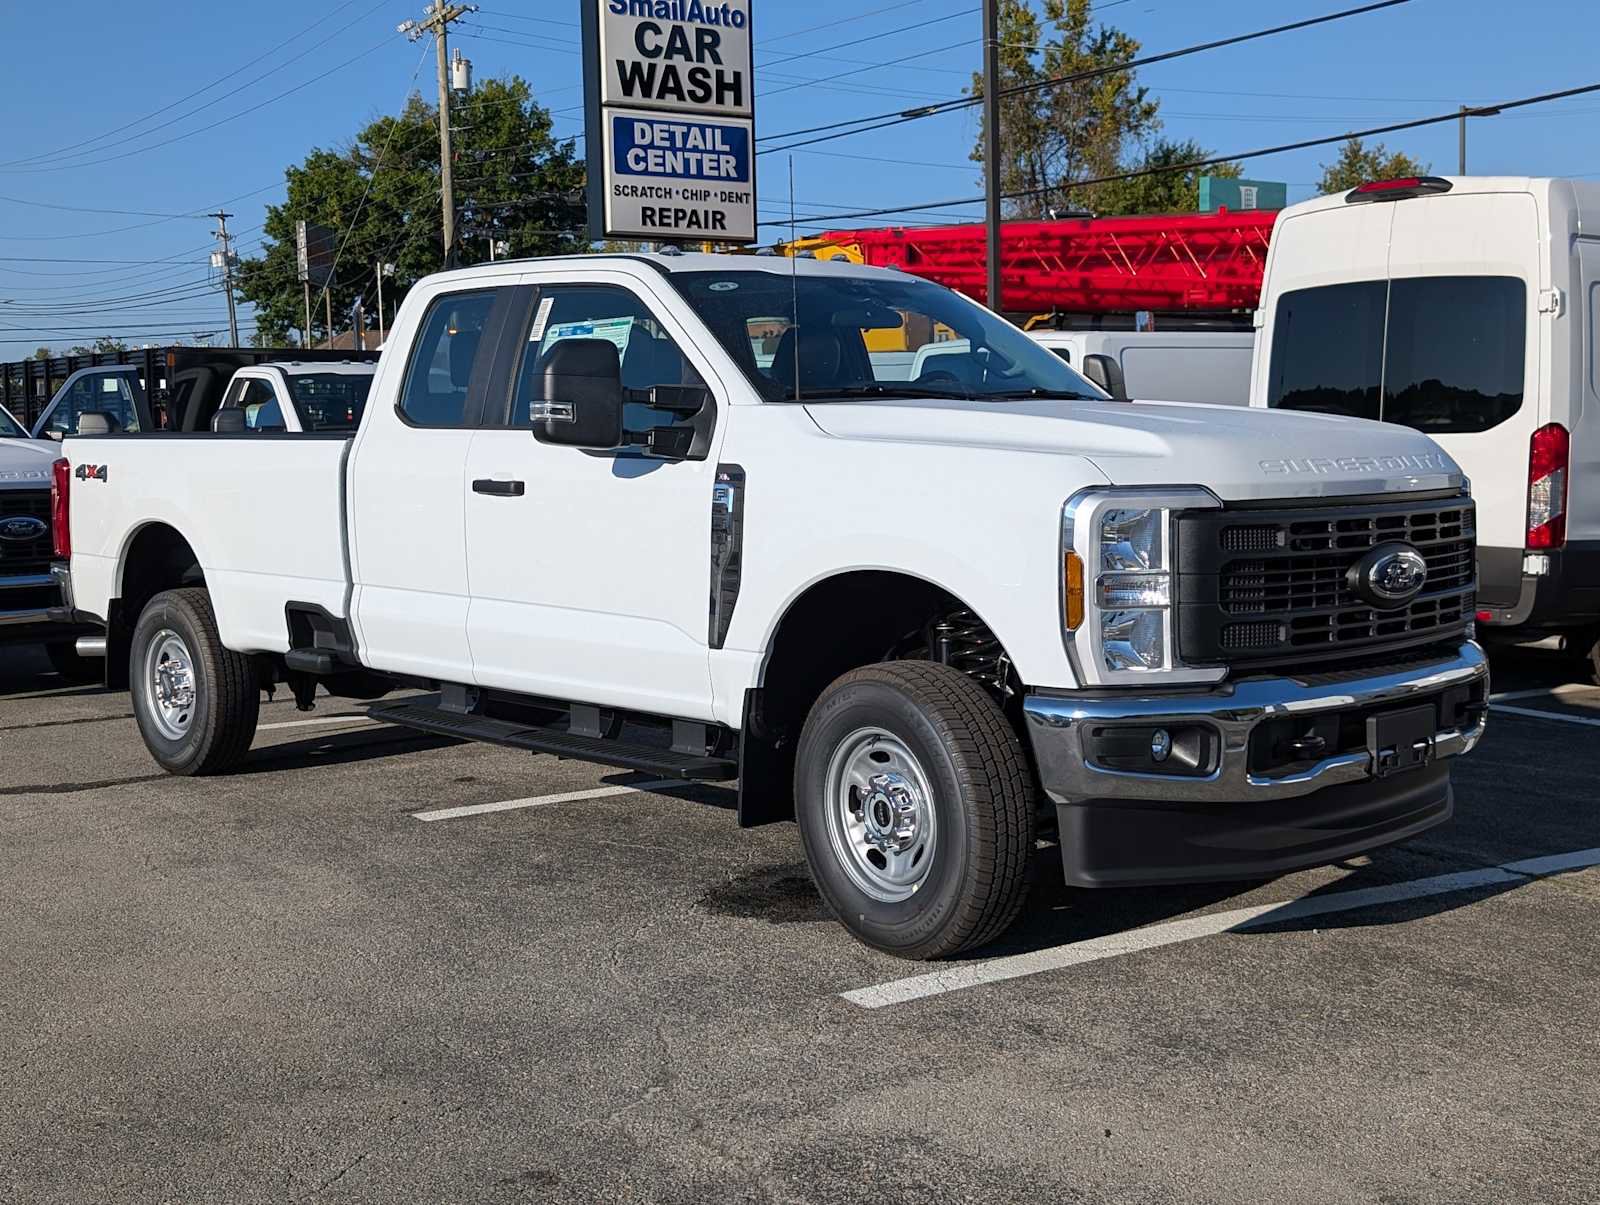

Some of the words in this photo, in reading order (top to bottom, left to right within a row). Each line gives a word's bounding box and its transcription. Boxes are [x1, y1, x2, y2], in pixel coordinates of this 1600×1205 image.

[608, 0, 745, 28] SmailAuto
[634, 21, 723, 64] CAR
[615, 59, 743, 107] WASH
[633, 121, 730, 151] DETAIL
[627, 148, 738, 178] CENTER
[614, 184, 672, 199] SCRATCH
[681, 188, 711, 202] CHIP
[719, 191, 751, 204] DENT
[641, 206, 727, 230] REPAIR
